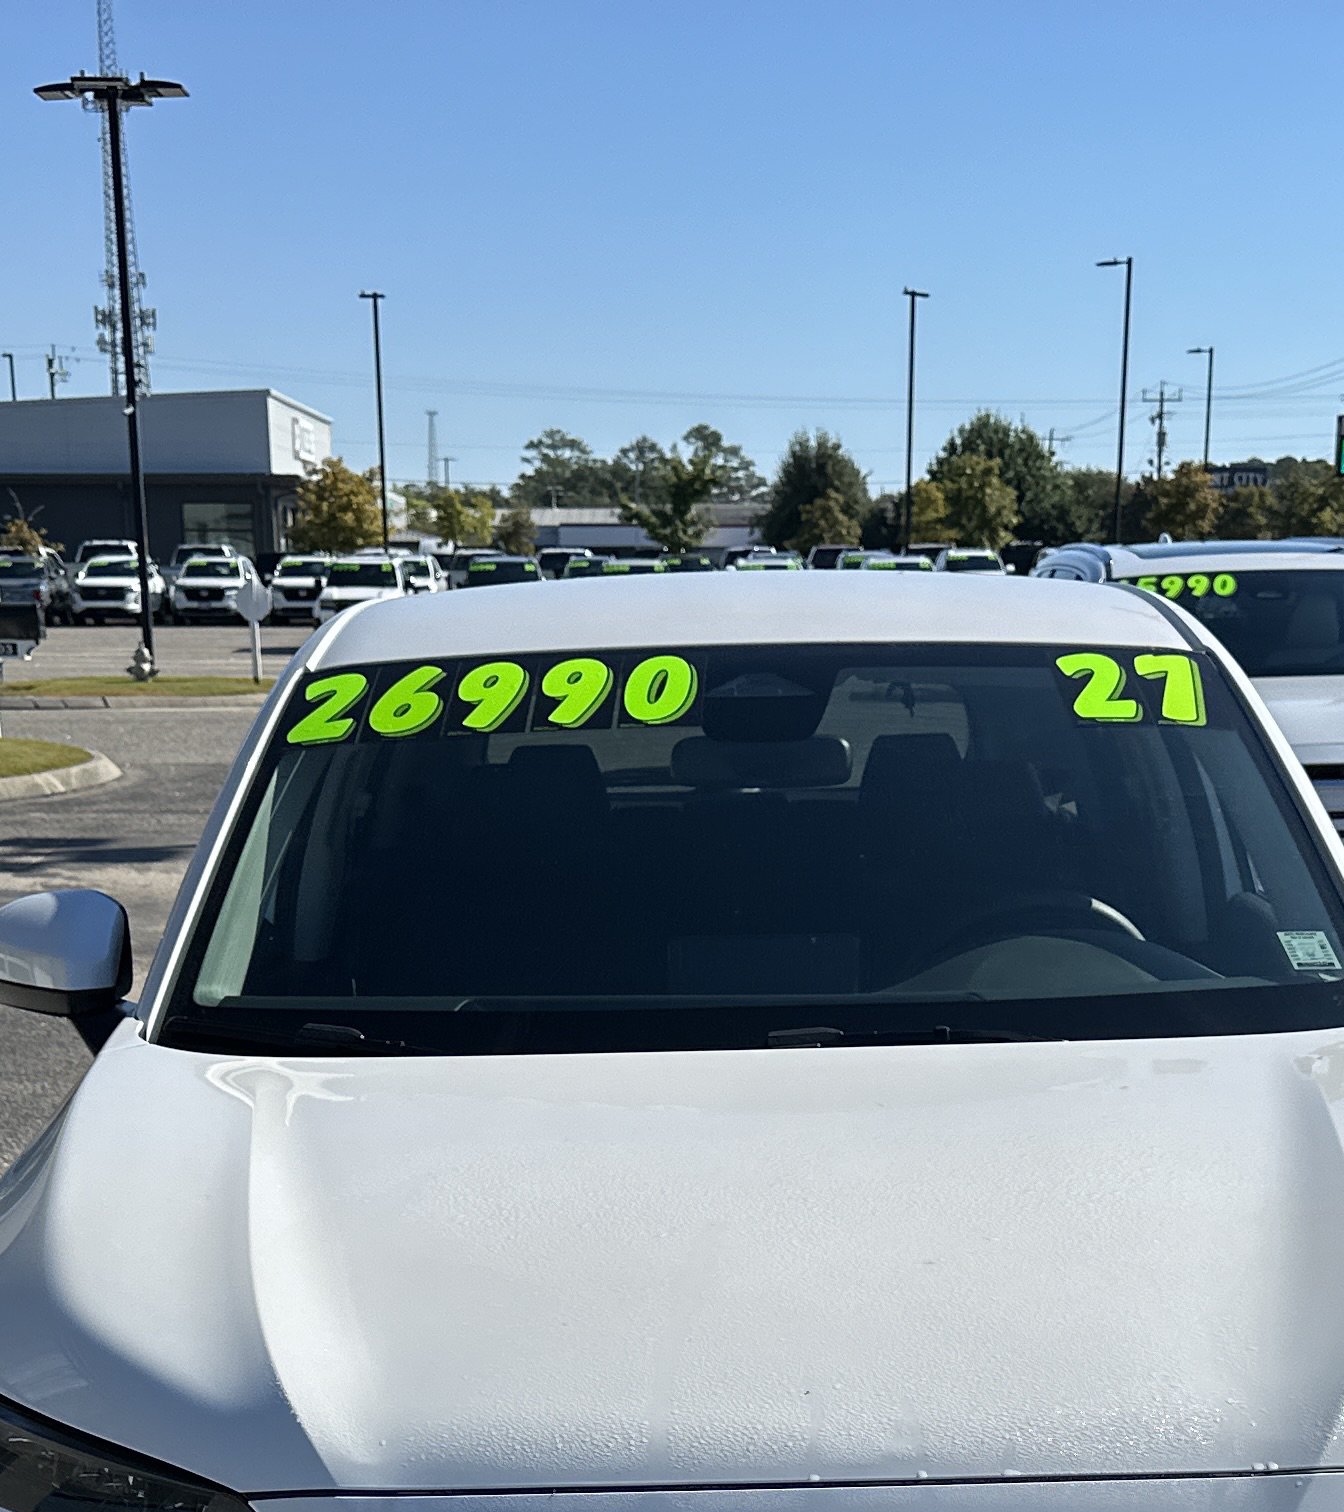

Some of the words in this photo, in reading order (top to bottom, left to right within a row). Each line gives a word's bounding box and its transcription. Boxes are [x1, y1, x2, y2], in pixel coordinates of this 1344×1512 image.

[1120, 574, 1238, 600] 5990
[286, 655, 698, 745] 26990
[1055, 653, 1207, 727] 27
